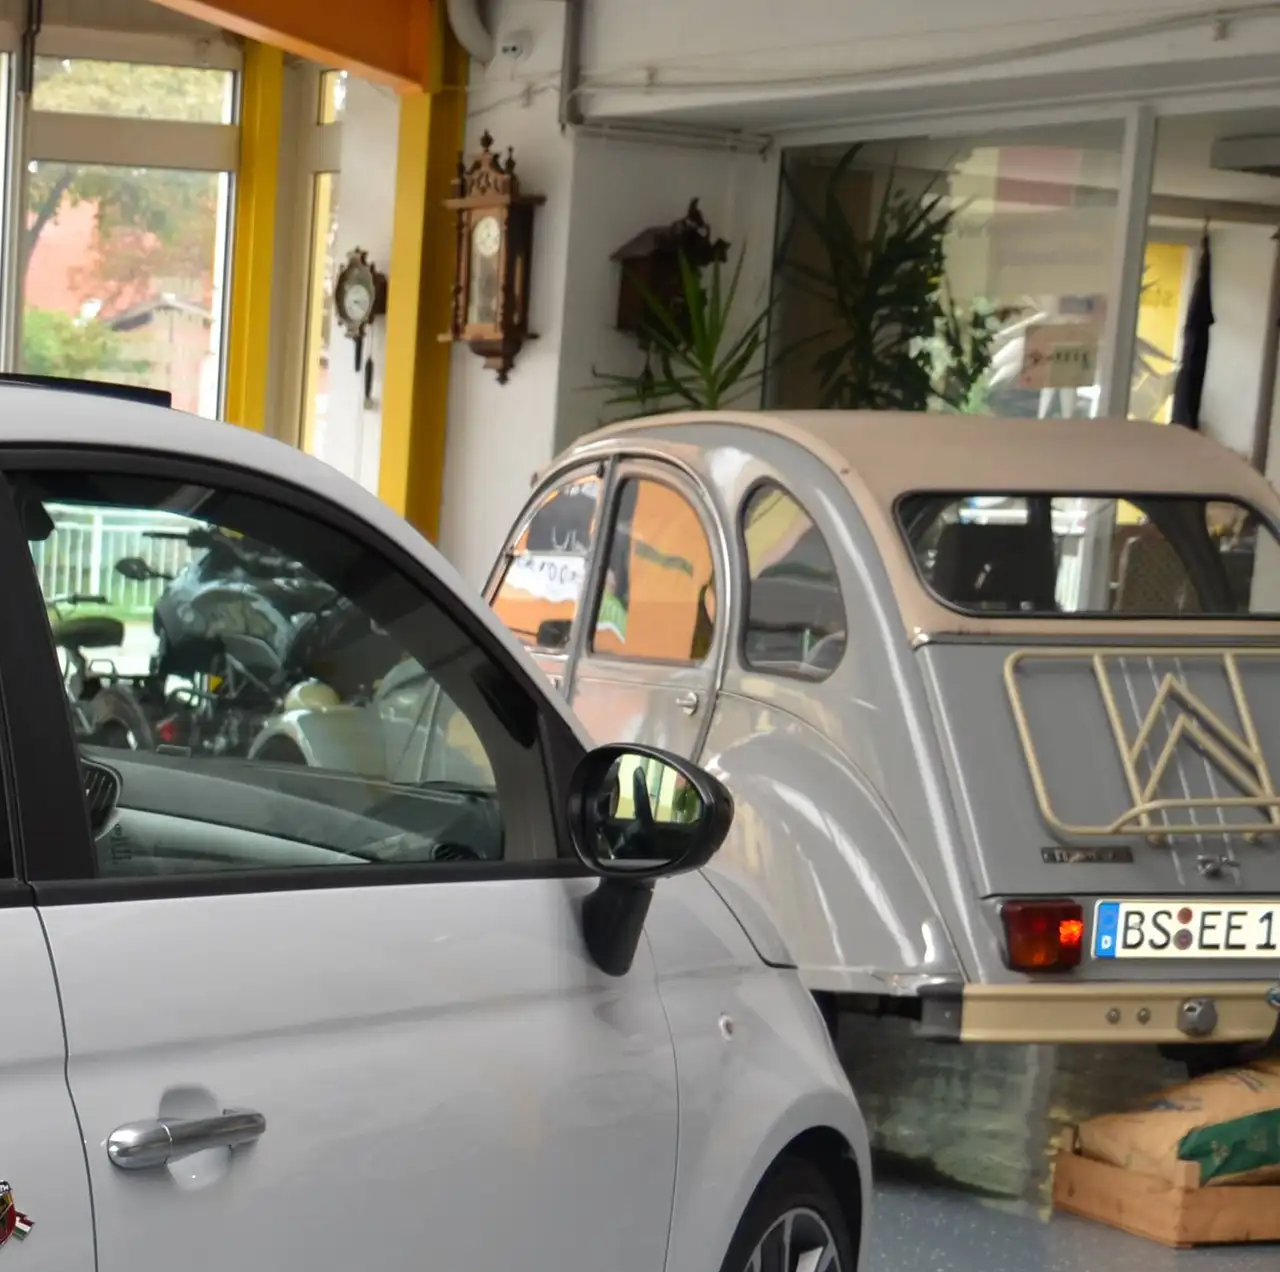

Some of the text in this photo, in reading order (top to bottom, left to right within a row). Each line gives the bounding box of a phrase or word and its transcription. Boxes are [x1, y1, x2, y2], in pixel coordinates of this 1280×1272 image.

[1122, 910, 1276, 950] BS EE 1
